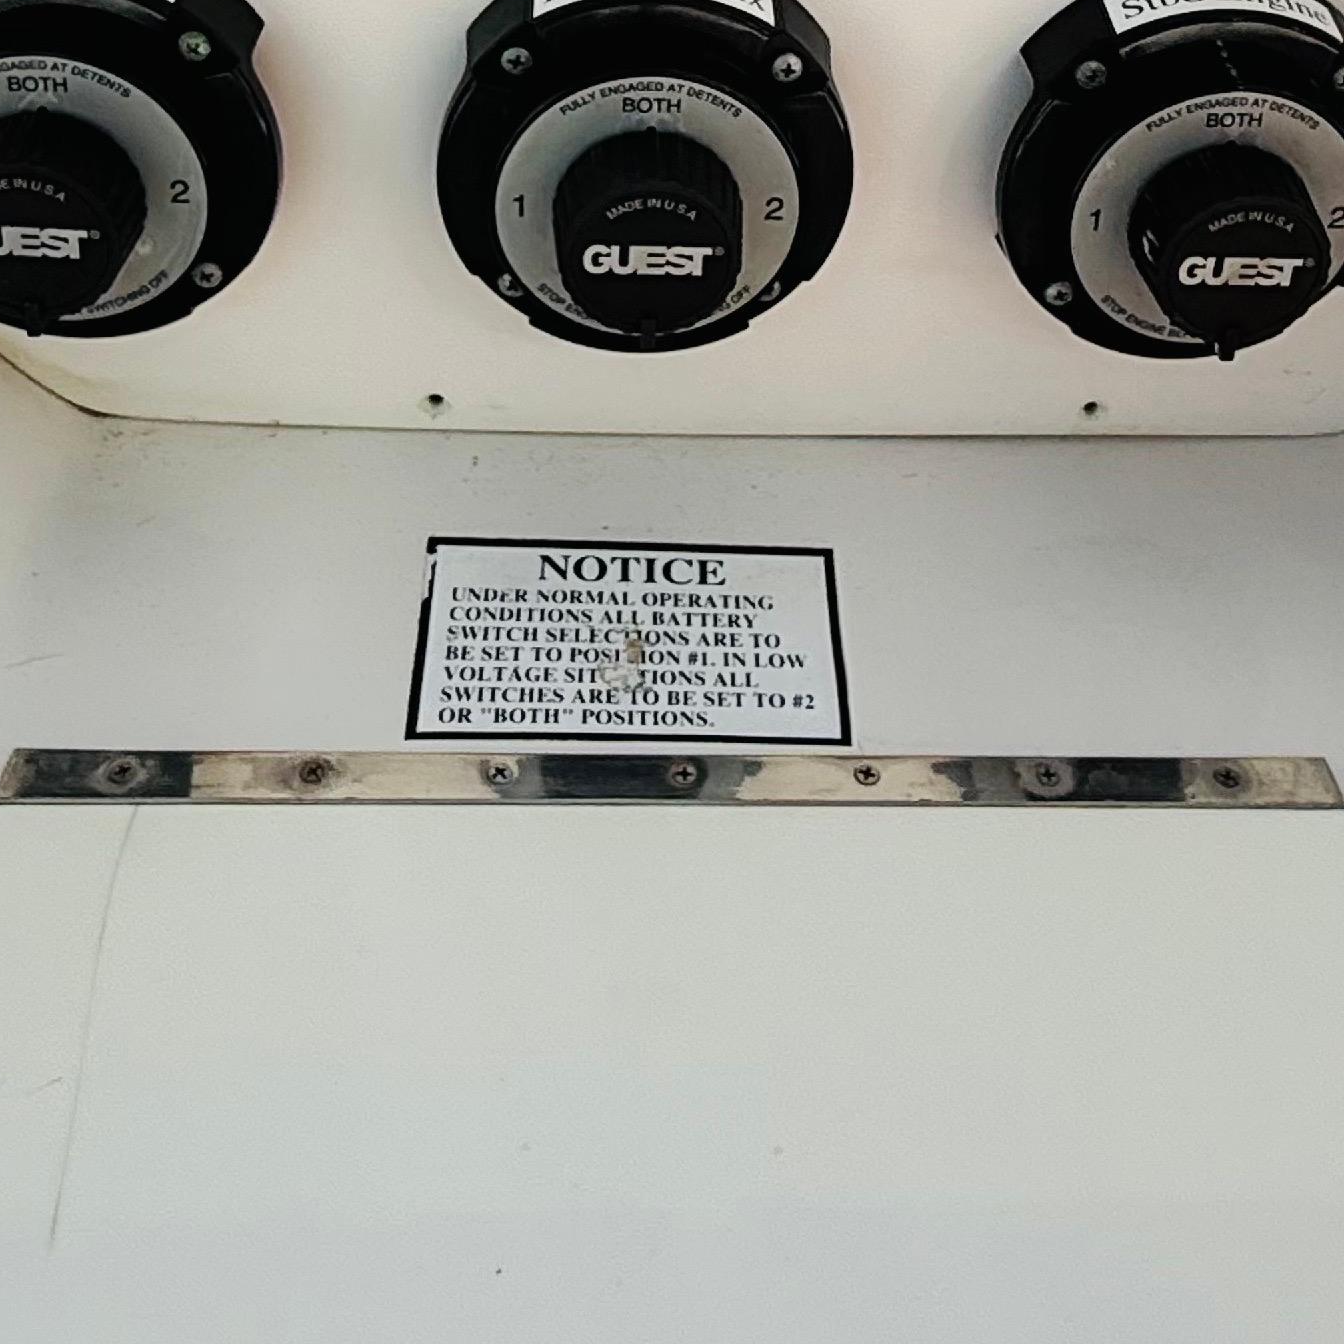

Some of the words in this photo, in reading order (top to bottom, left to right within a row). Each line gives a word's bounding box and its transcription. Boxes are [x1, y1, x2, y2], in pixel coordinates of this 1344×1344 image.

[7, 76, 68, 93] BOTH
[50, 62, 68, 73] AT
[70, 65, 132, 98] DETENTS
[559, 90, 596, 116] FULLY
[599, 81, 664, 98] ENGAGED
[667, 83, 685, 94] AT
[687, 86, 743, 118] DETENTS
[622, 97, 682, 114] BOTH
[1145, 109, 1183, 133] FULLY
[1186, 97, 1249, 114] ENGAGED
[1250, 98, 1268, 108] AT
[1268, 100, 1321, 130] DETENTS
[1206, 112, 1264, 128] BOTH
[13, 178, 27, 190] IN
[169, 180, 191, 204] 2
[513, 195, 525, 217] 1
[606, 198, 644, 220] MADE
[647, 198, 662, 208] IN
[764, 197, 784, 221] 2
[1088, 208, 1103, 232] 1
[1208, 211, 1246, 232] MADE
[1248, 211, 1263, 222] IN
[582, 244, 713, 277] GUEST
[1178, 256, 1304, 287] GUEST
[538, 554, 726, 586] NOTICE
[452, 587, 528, 603] UNDER
[536, 589, 636, 606] NORMAL
[641, 591, 774, 611] OPERATING
[449, 606, 593, 623] CONDITIONS
[599, 610, 645, 626] ALL
[652, 611, 758, 629] BATTERY
[446, 625, 538, 642] SWITCH
[697, 632, 744, 648] ARE
[750, 633, 781, 649] TO
[445, 645, 474, 661] BE
[481, 645, 524, 662] SET
[530, 646, 563, 662] TO
[569, 647, 681, 665] POSIION
[723, 652, 746, 667] IN
[754, 652, 807, 669] LOW
[444, 666, 558, 682] VOLTAGE
[564, 667, 706, 686] SITTIONS
[713, 672, 760, 688] ALL
[440, 686, 565, 703] SWITCHES
[571, 687, 620, 704] ARE
[629, 688, 660, 705] TO
[667, 690, 697, 706] BE
[703, 691, 745, 707] SET
[754, 692, 786, 708] TO
[792, 694, 814, 710] #2
[438, 707, 472, 723] OR
[480, 707, 574, 724] "BOTH"
[581, 708, 716, 727] POSITIONS.
